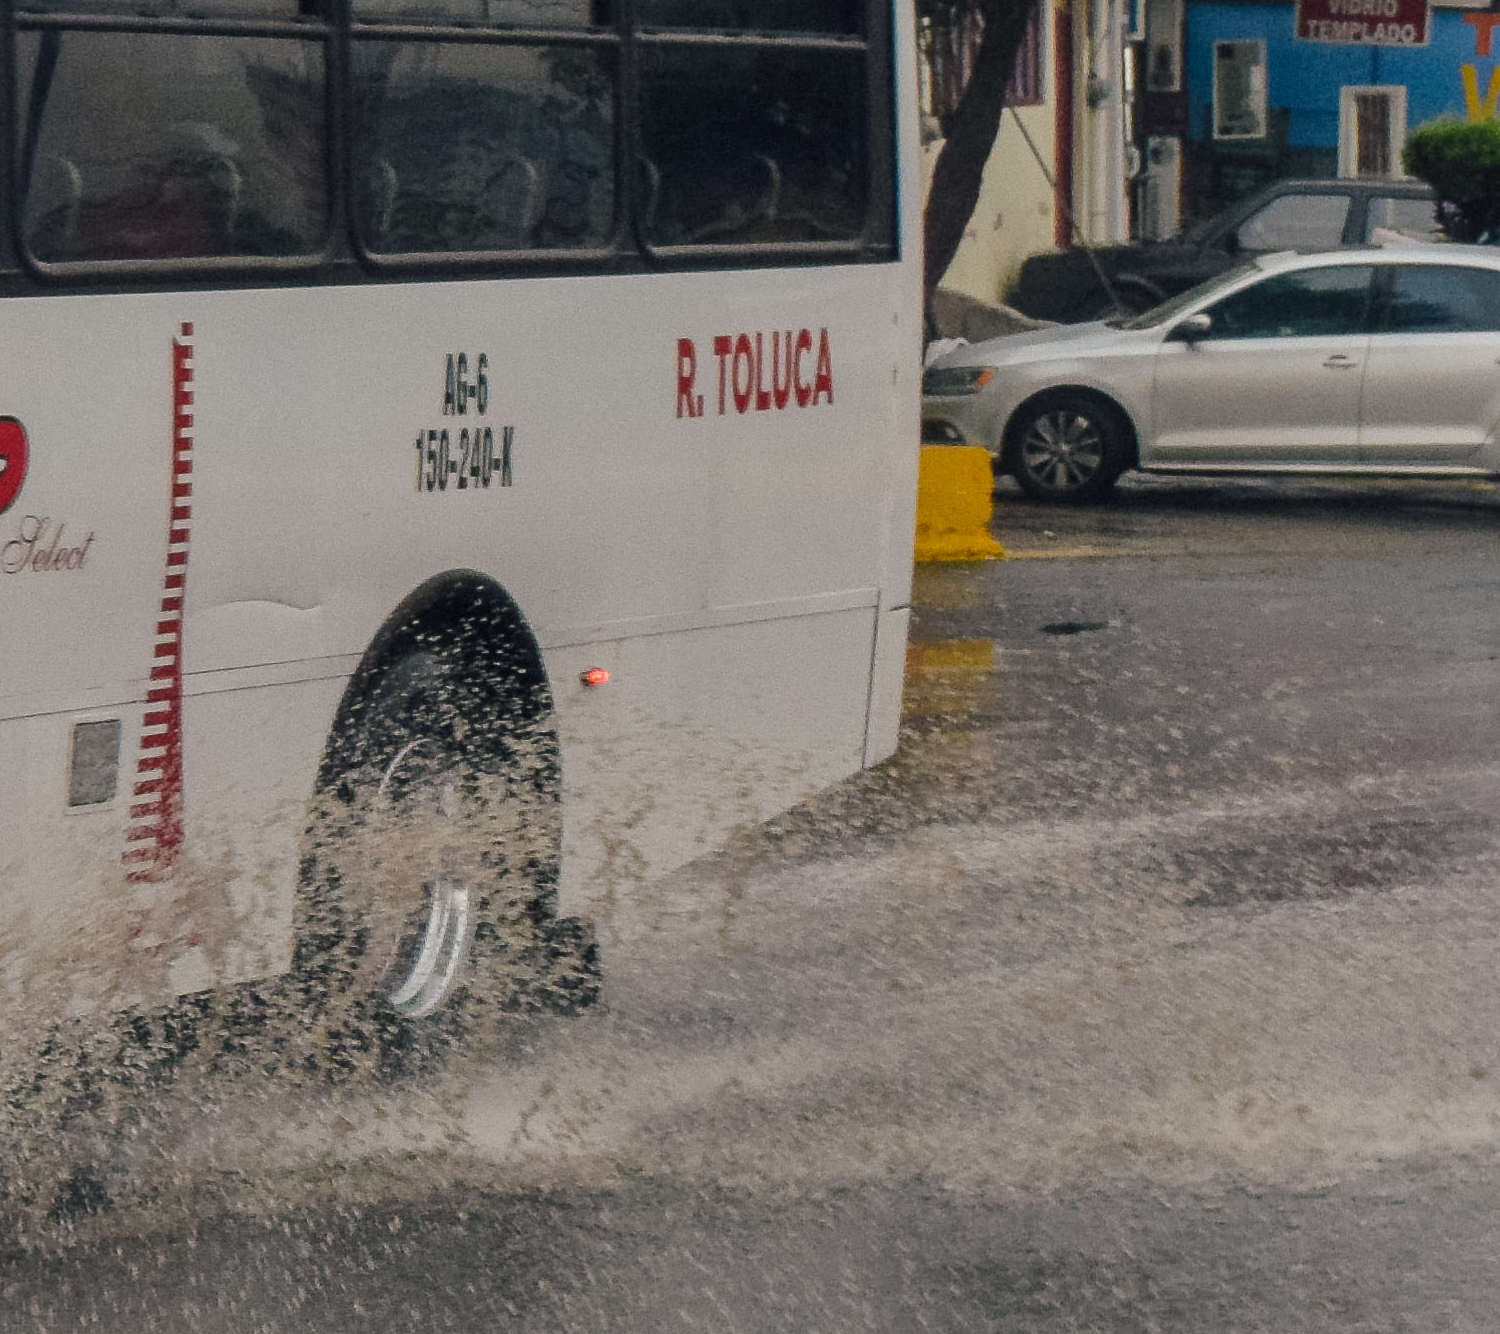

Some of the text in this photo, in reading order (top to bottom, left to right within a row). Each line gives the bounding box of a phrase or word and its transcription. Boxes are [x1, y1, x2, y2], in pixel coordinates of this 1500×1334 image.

[1307, 20, 1417, 43] TEMPLADO
[442, 352, 488, 416] AG-6
[676, 327, 833, 418] R. TOLUCA
[414, 425, 515, 492] 150-240-K
[2, 515, 95, 574] Select
